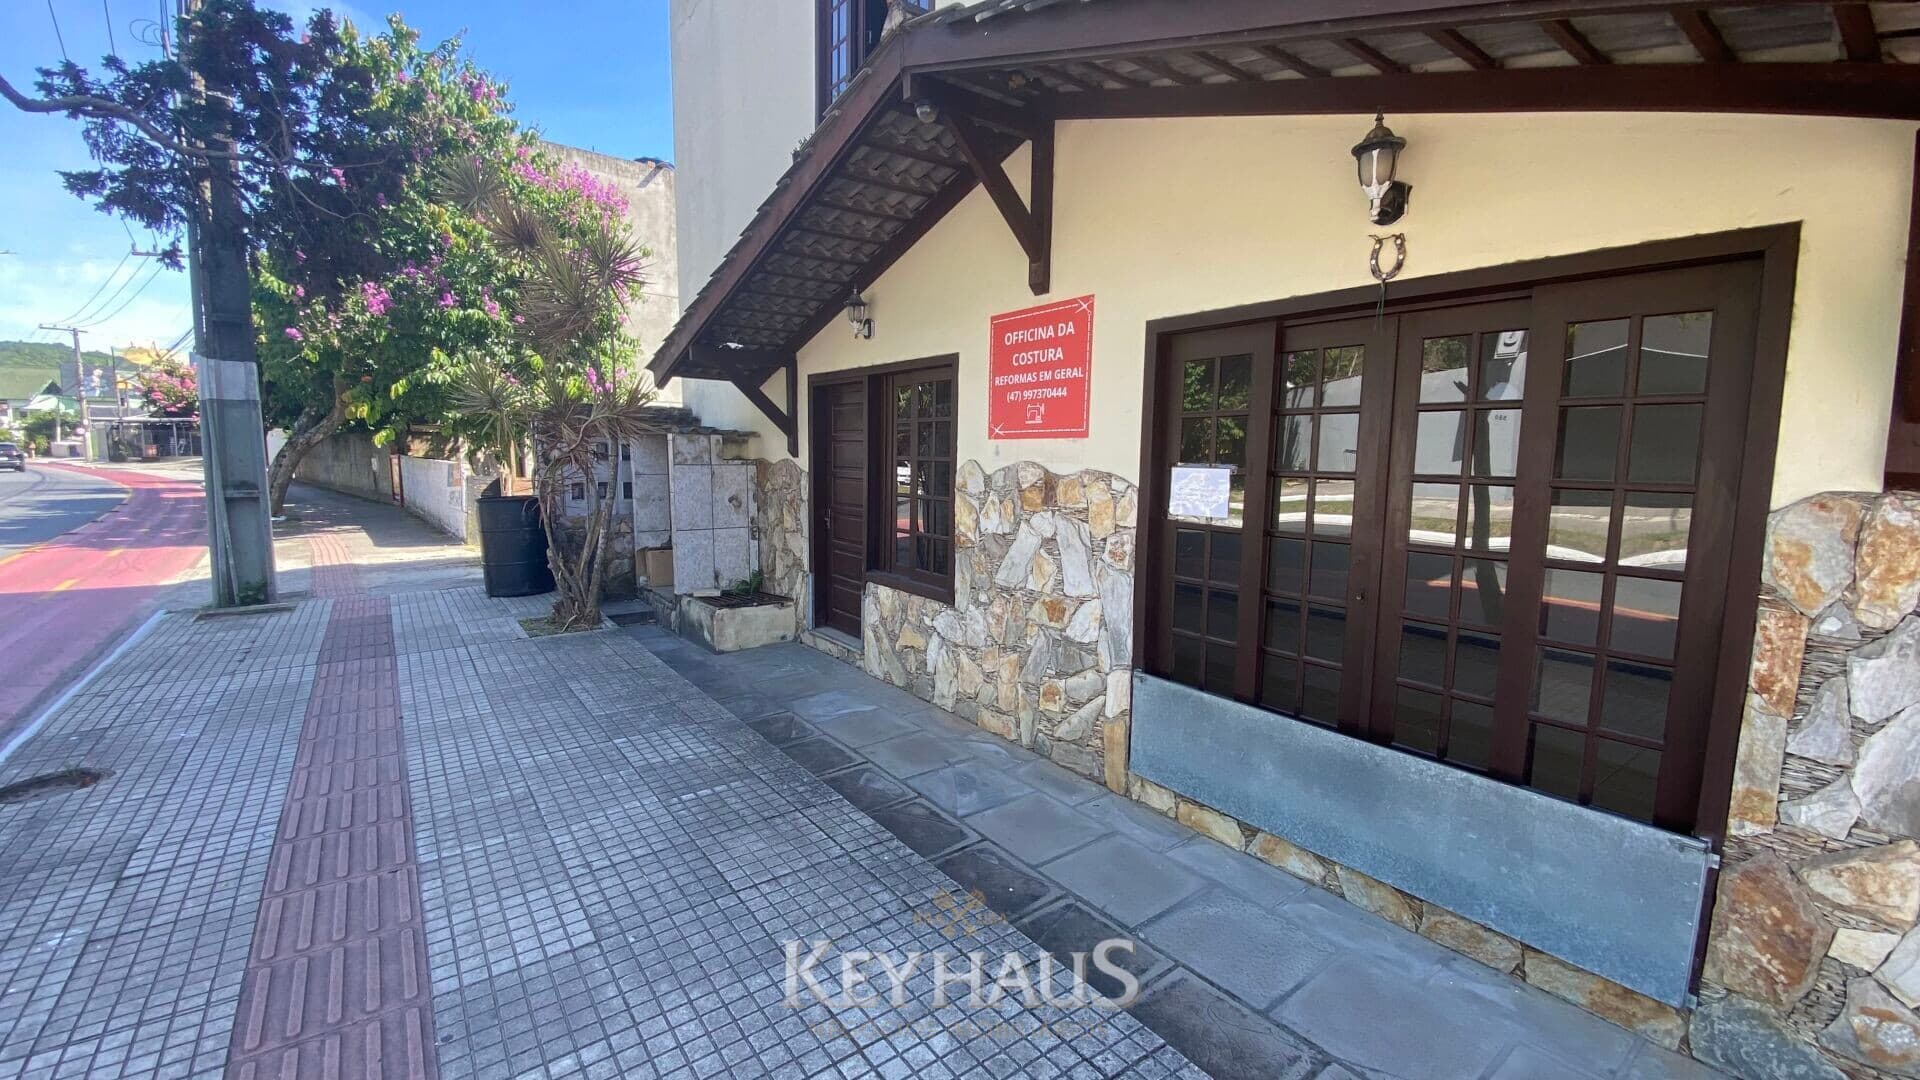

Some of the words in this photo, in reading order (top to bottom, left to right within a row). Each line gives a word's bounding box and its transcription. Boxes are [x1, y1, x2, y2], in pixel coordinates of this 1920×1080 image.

[1004, 325, 1054, 345] OFFICINA
[1057, 321, 1075, 336] DA
[1012, 347, 1064, 366] COSTURA
[995, 371, 1038, 387] REFORMAS
[1039, 370, 1052, 382] EM
[1054, 367, 1084, 380] GERAL
[1007, 391, 1021, 402] (47)
[1023, 386, 1067, 401] 997370444
